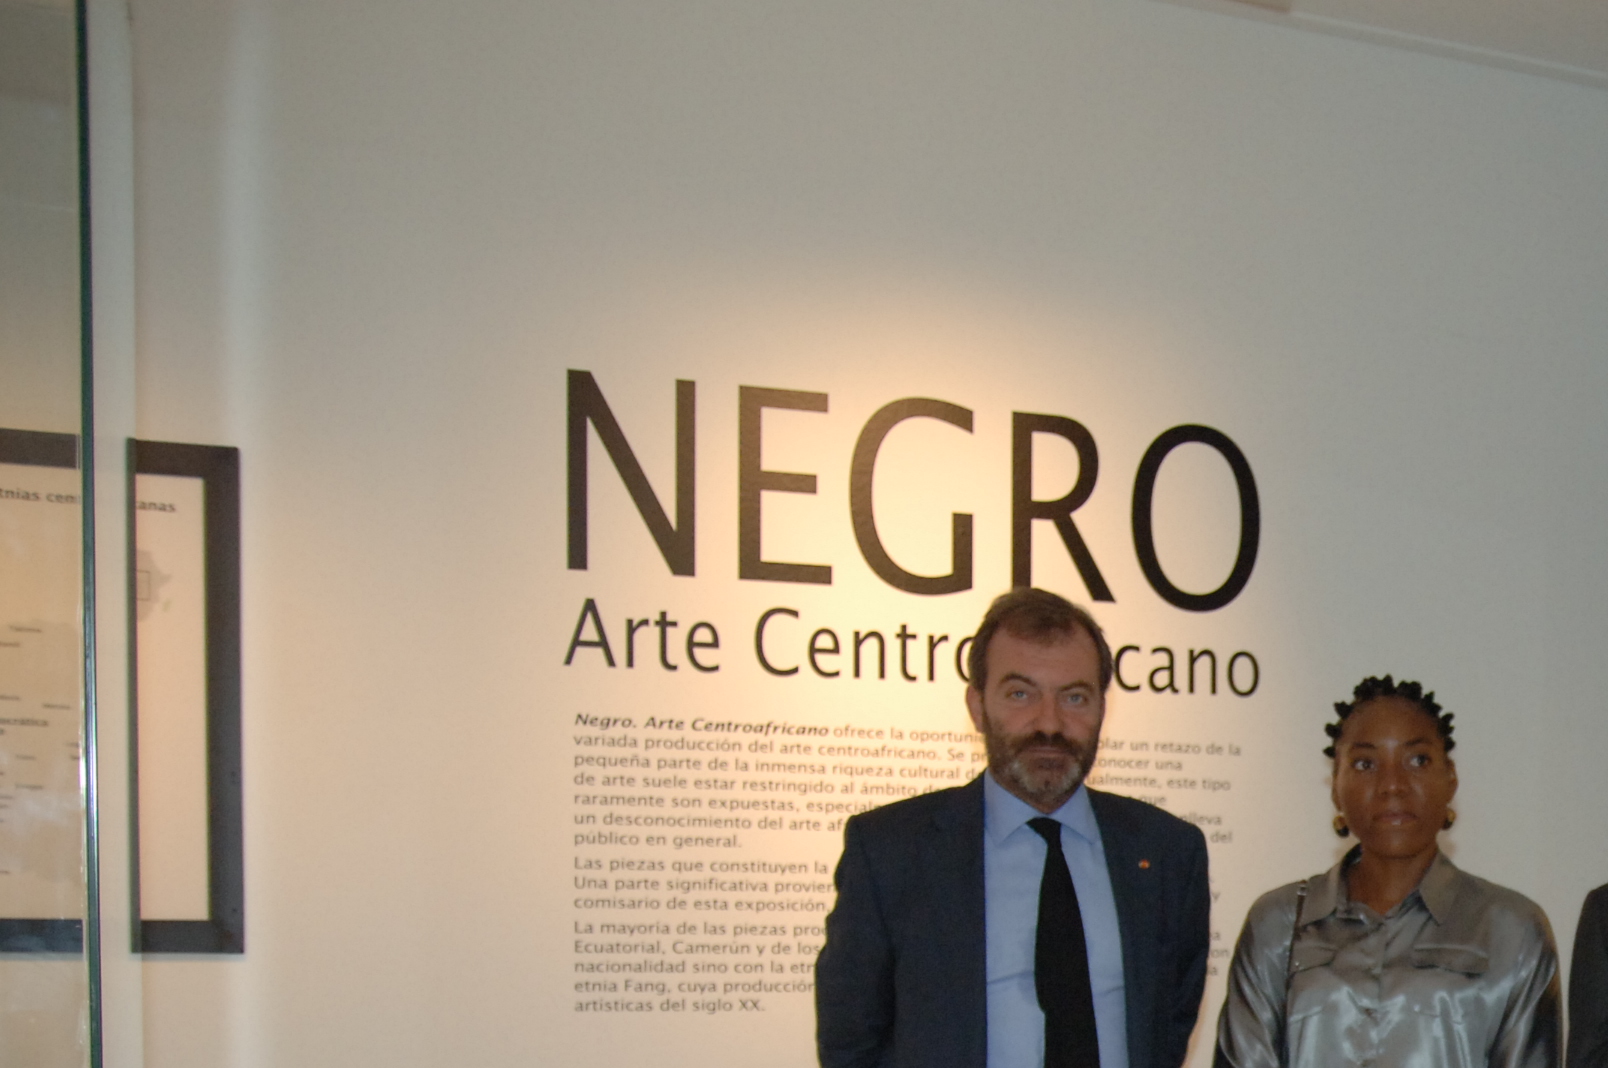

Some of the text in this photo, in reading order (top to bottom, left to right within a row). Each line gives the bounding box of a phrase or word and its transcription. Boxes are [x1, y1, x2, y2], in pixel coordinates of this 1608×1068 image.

[566, 368, 1261, 613] NEGRO
[563, 598, 721, 673] Arte
[575, 713, 637, 730] Negro.
[645, 716, 684, 731] Arte
[692, 718, 828, 737] Centroafricano
[834, 725, 884, 739] ofrece
[891, 727, 903, 740] la
[574, 734, 637, 748] variada
[644, 735, 742, 753] producción
[749, 740, 773, 754] del
[780, 743, 811, 756] arte
[818, 744, 942, 760] centroafricano.
[948, 748, 965, 762] Se
[1130, 741, 1149, 751] un
[1154, 741, 1201, 754] retazo
[1205, 742, 1223, 755] de
[1229, 744, 1241, 756] la
[574, 753, 650, 768] pequeña
[657, 757, 701, 771] parte
[708, 757, 728, 771] de
[735, 758, 748, 772] la
[756, 760, 825, 775] inmensa
[832, 764, 893, 777] riqueza
[900, 765, 960, 780] cultural
[1155, 759, 1182, 770] una
[574, 773, 595, 786] de
[602, 775, 635, 787] arte
[642, 775, 687, 789] suele
[694, 779, 735, 790] estar
[742, 780, 834, 795] restringido
[841, 782, 854, 794] al
[860, 783, 918, 797] ámbito
[1167, 779, 1197, 789] este
[1202, 779, 1231, 792] tipo
[574, 793, 664, 807] raramente
[671, 797, 701, 808] son
[708, 798, 800, 812] expuestas,
[574, 813, 596, 825] un
[603, 812, 751, 829] desconocimiento
[758, 817, 782, 830] del
[789, 819, 821, 832] arte
[574, 832, 742, 849] público en general.
[575, 857, 828, 875] Las piezas que constituyen la
[575, 876, 608, 890] Una
[615, 878, 660, 893] parte
[667, 878, 768, 894] significativa
[574, 896, 660, 909] comisario
[667, 897, 687, 910] de
[694, 899, 728, 911] esta
[575, 921, 593, 934] La
[600, 921, 670, 937] mayoría
[676, 922, 696, 935] de
[703, 922, 726, 935] las
[733, 924, 786, 938] piezas
[575, 941, 665, 954] Ecuatorial,
[672, 941, 750, 955] Camerún
[756, 944, 766, 957] y
[771, 941, 791, 955] de
[574, 961, 685, 974] nacionalidad
[692, 961, 726, 974] sino
[734, 962, 763, 974] con
[770, 961, 784, 974] la
[574, 980, 617, 992] etnia
[624, 980, 671, 995] Fang,
[678, 982, 716, 995] cuya
[574, 999, 765, 1014] artísticas del siglo XX.
